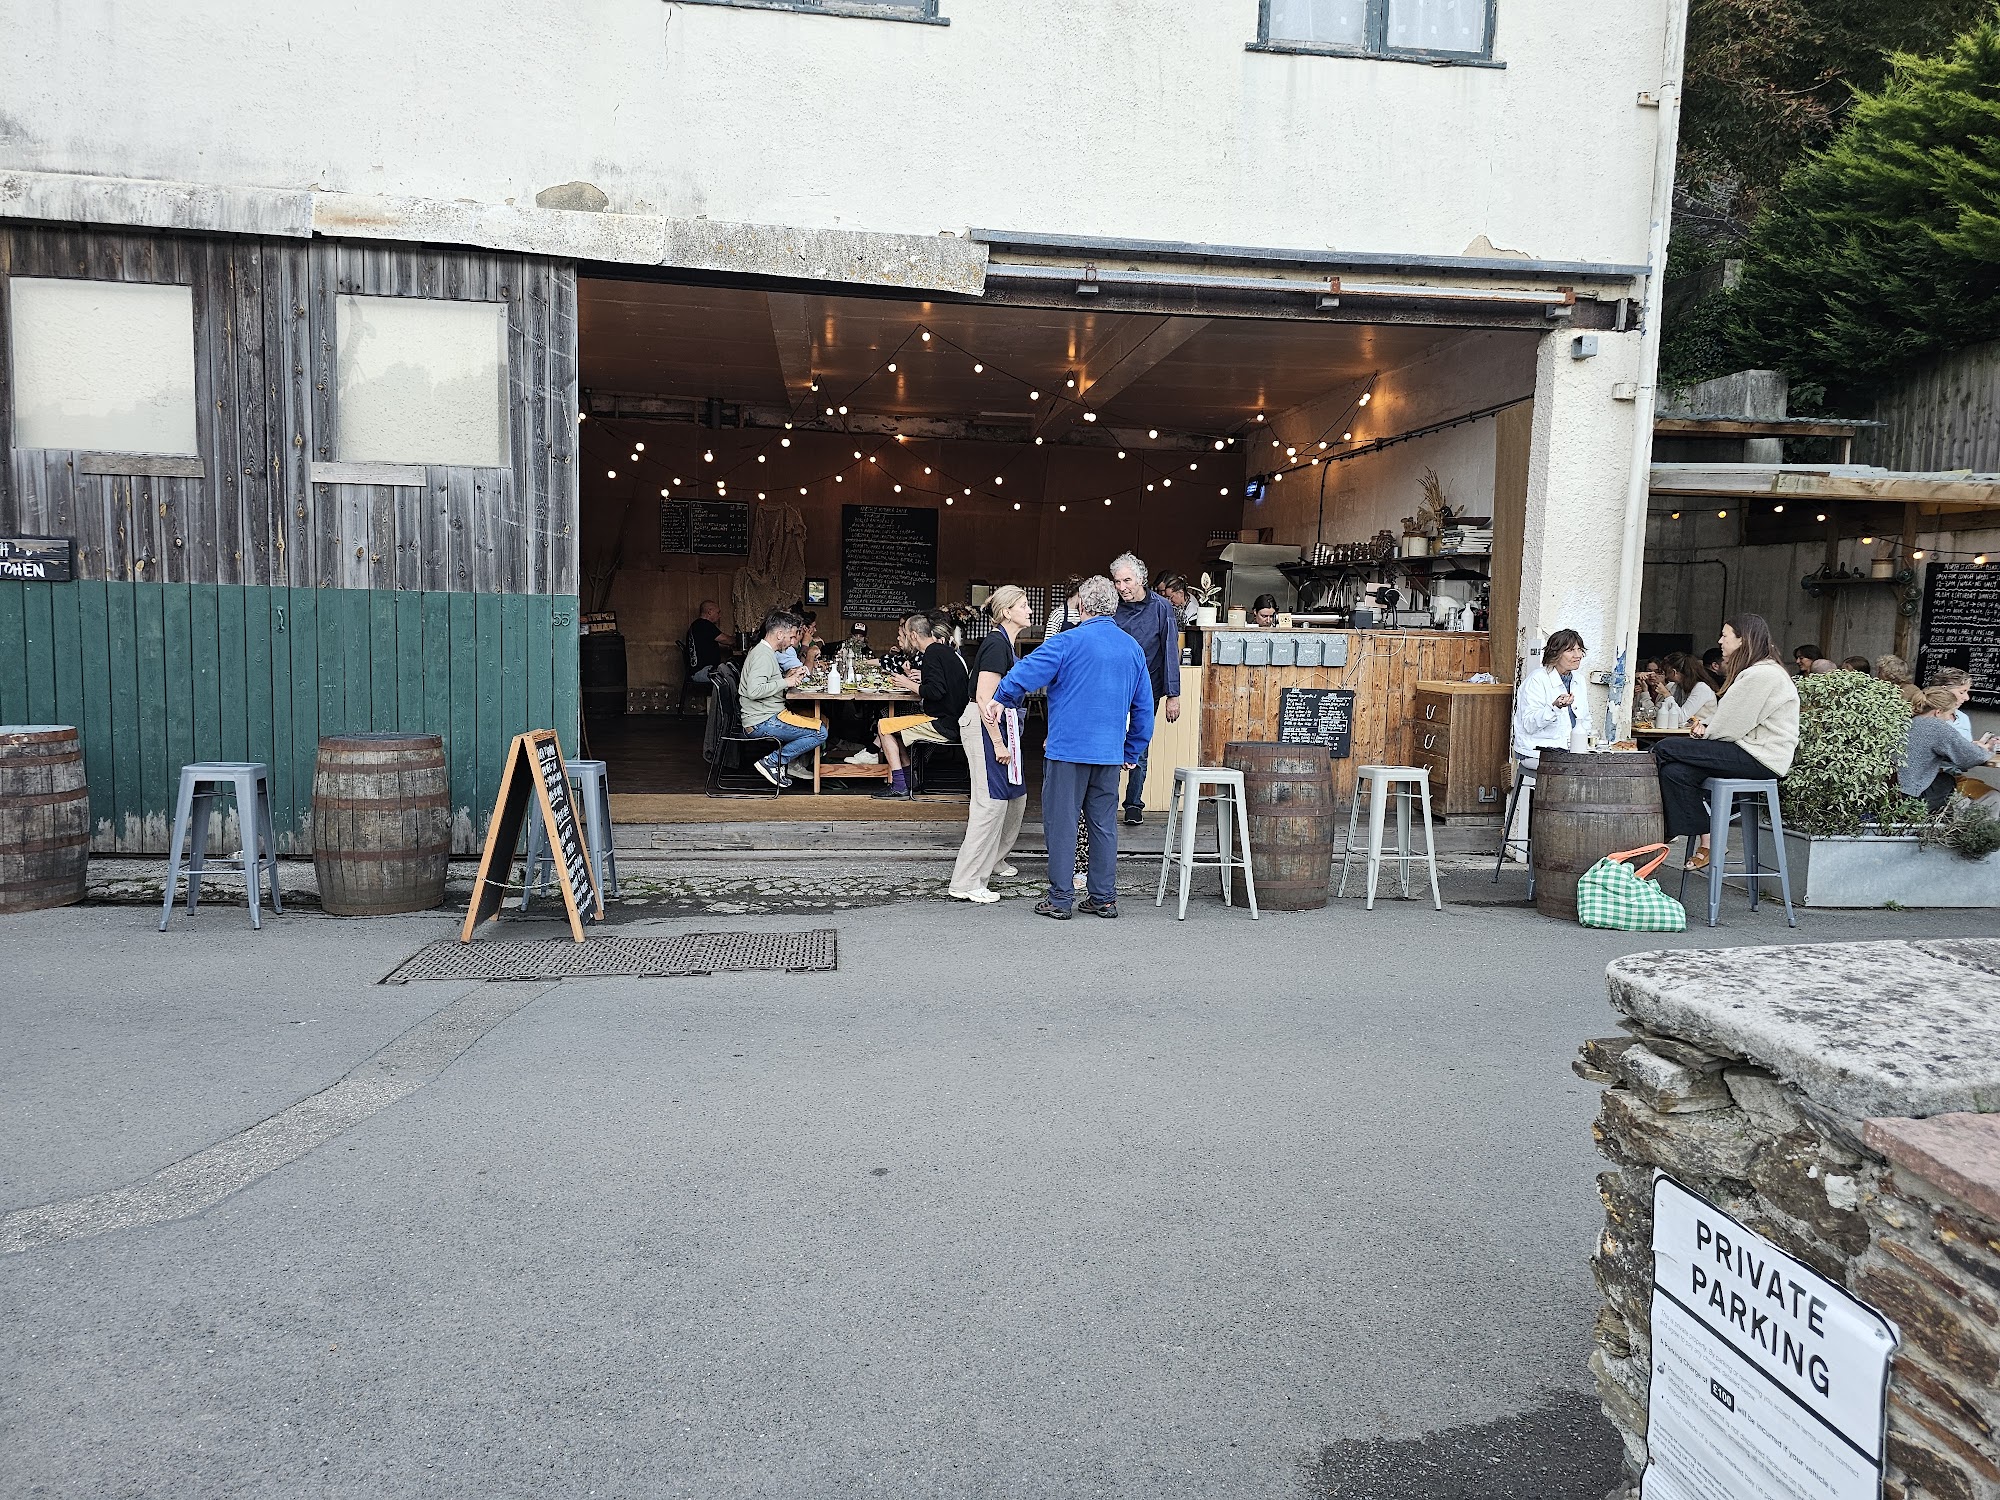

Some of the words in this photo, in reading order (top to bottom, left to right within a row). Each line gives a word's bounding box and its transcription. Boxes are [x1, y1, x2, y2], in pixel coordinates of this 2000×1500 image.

[553, 611, 570, 626] 55
[1691, 1263, 1830, 1398] PARKING
[1696, 1219, 1828, 1339] PRIVATE
[1664, 1340, 1682, 1364] Parking
[1683, 1357, 1700, 1380] Charge
[1712, 1381, 1732, 1408] £100
[1736, 1403, 1746, 1418] will
[1747, 1412, 1754, 1425] be
[1756, 1420, 1781, 1449] incurred
[1788, 1449, 1803, 1468] your
[1805, 1462, 1828, 1489] vehicle
[1715, 1354, 1732, 1374] parking
